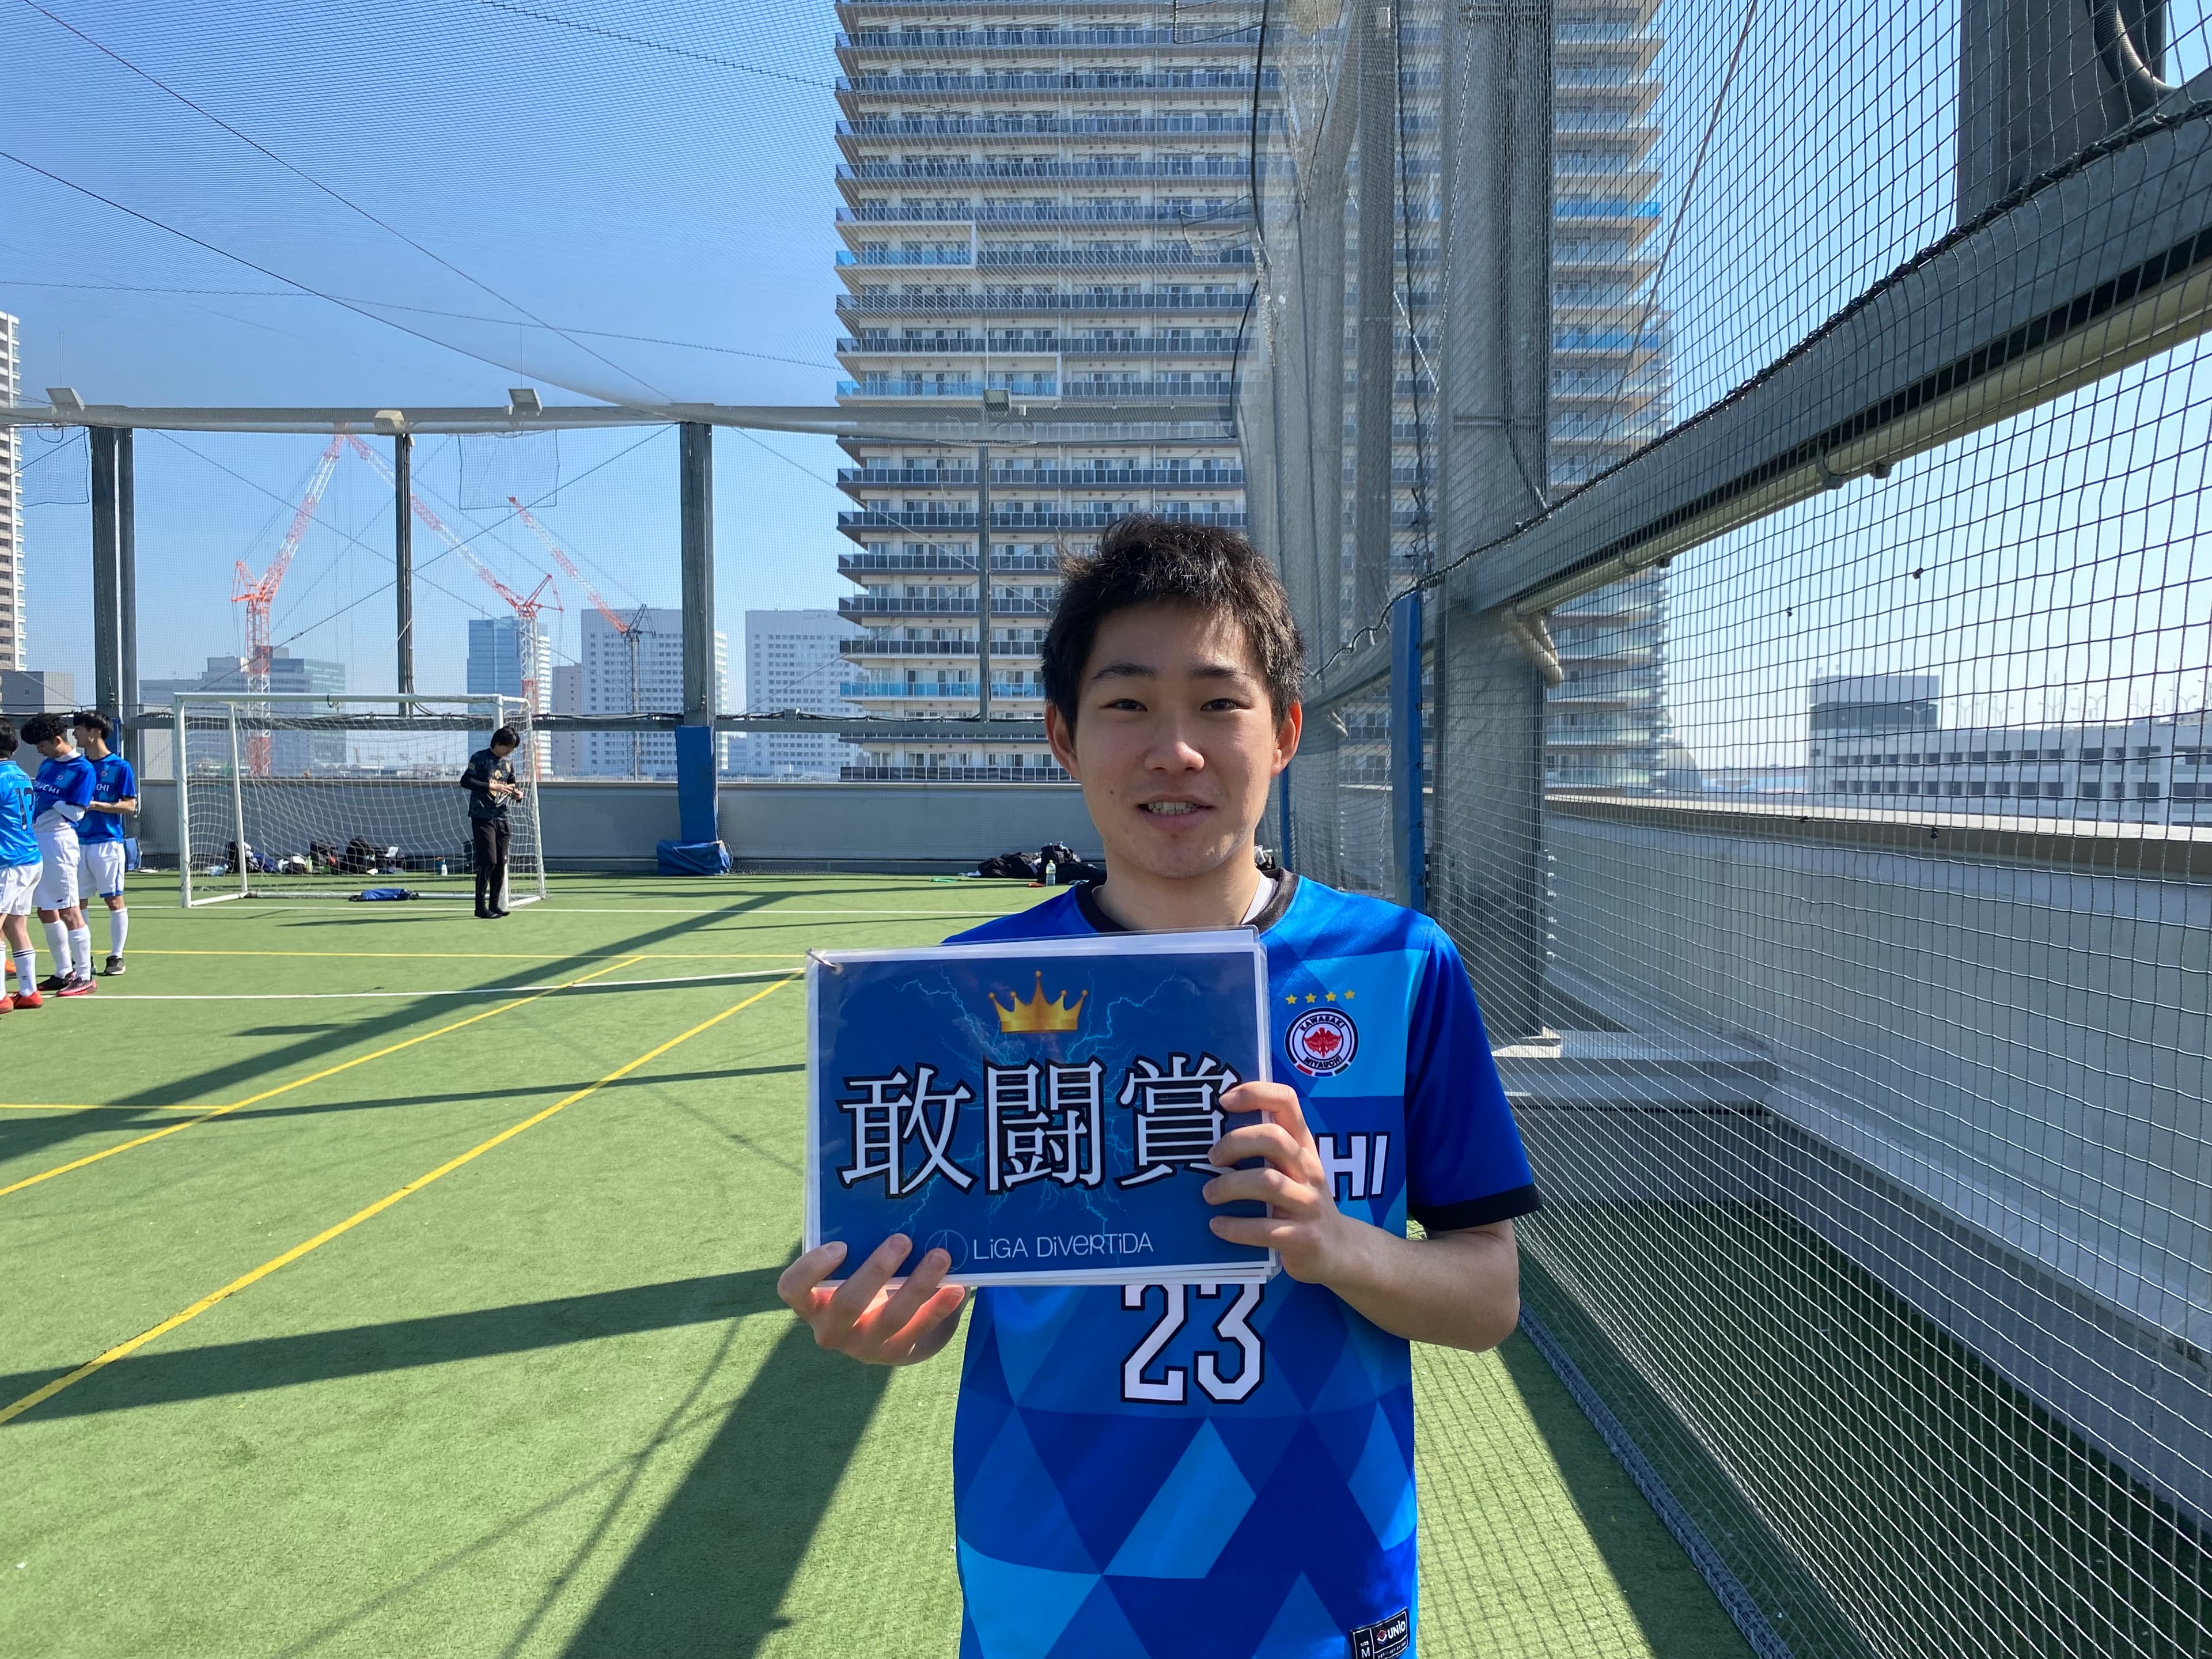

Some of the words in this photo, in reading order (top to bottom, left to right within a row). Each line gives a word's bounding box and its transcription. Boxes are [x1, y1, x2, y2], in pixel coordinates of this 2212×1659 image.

[1300, 1015, 1346, 1031] KAWASAKI
[1304, 1055, 1343, 1069] MIYAUCHI
[836, 1052, 1243, 1199] 敢闘賞
[1120, 1283, 1265, 1405] 23
[1361, 1647, 1370, 1658] M
